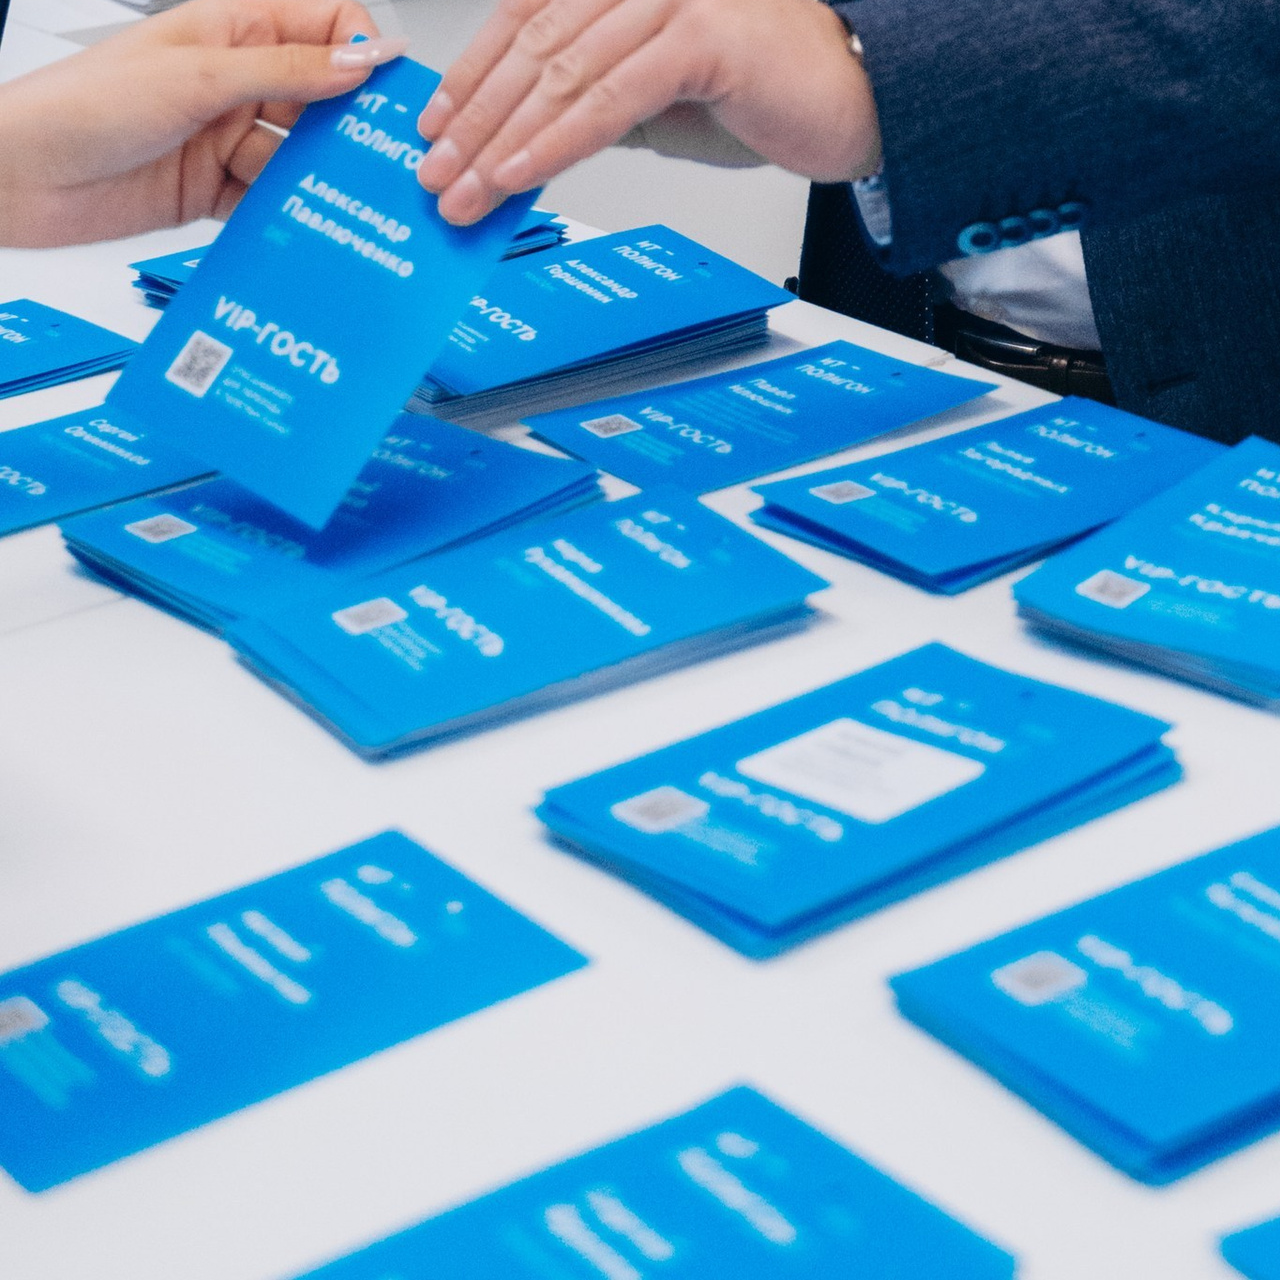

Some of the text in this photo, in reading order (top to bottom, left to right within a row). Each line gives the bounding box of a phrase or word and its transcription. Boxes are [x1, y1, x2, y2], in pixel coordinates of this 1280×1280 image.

[336, 113, 427, 171] ПОЛИГО
[282, 195, 414, 278] Павлюченко
[299, 173, 412, 244] Александр
[564, 259, 638, 300] Александр
[612, 244, 683, 281] ПОЛИГОН
[214, 295, 340, 384] VIP-ГОСТЬ
